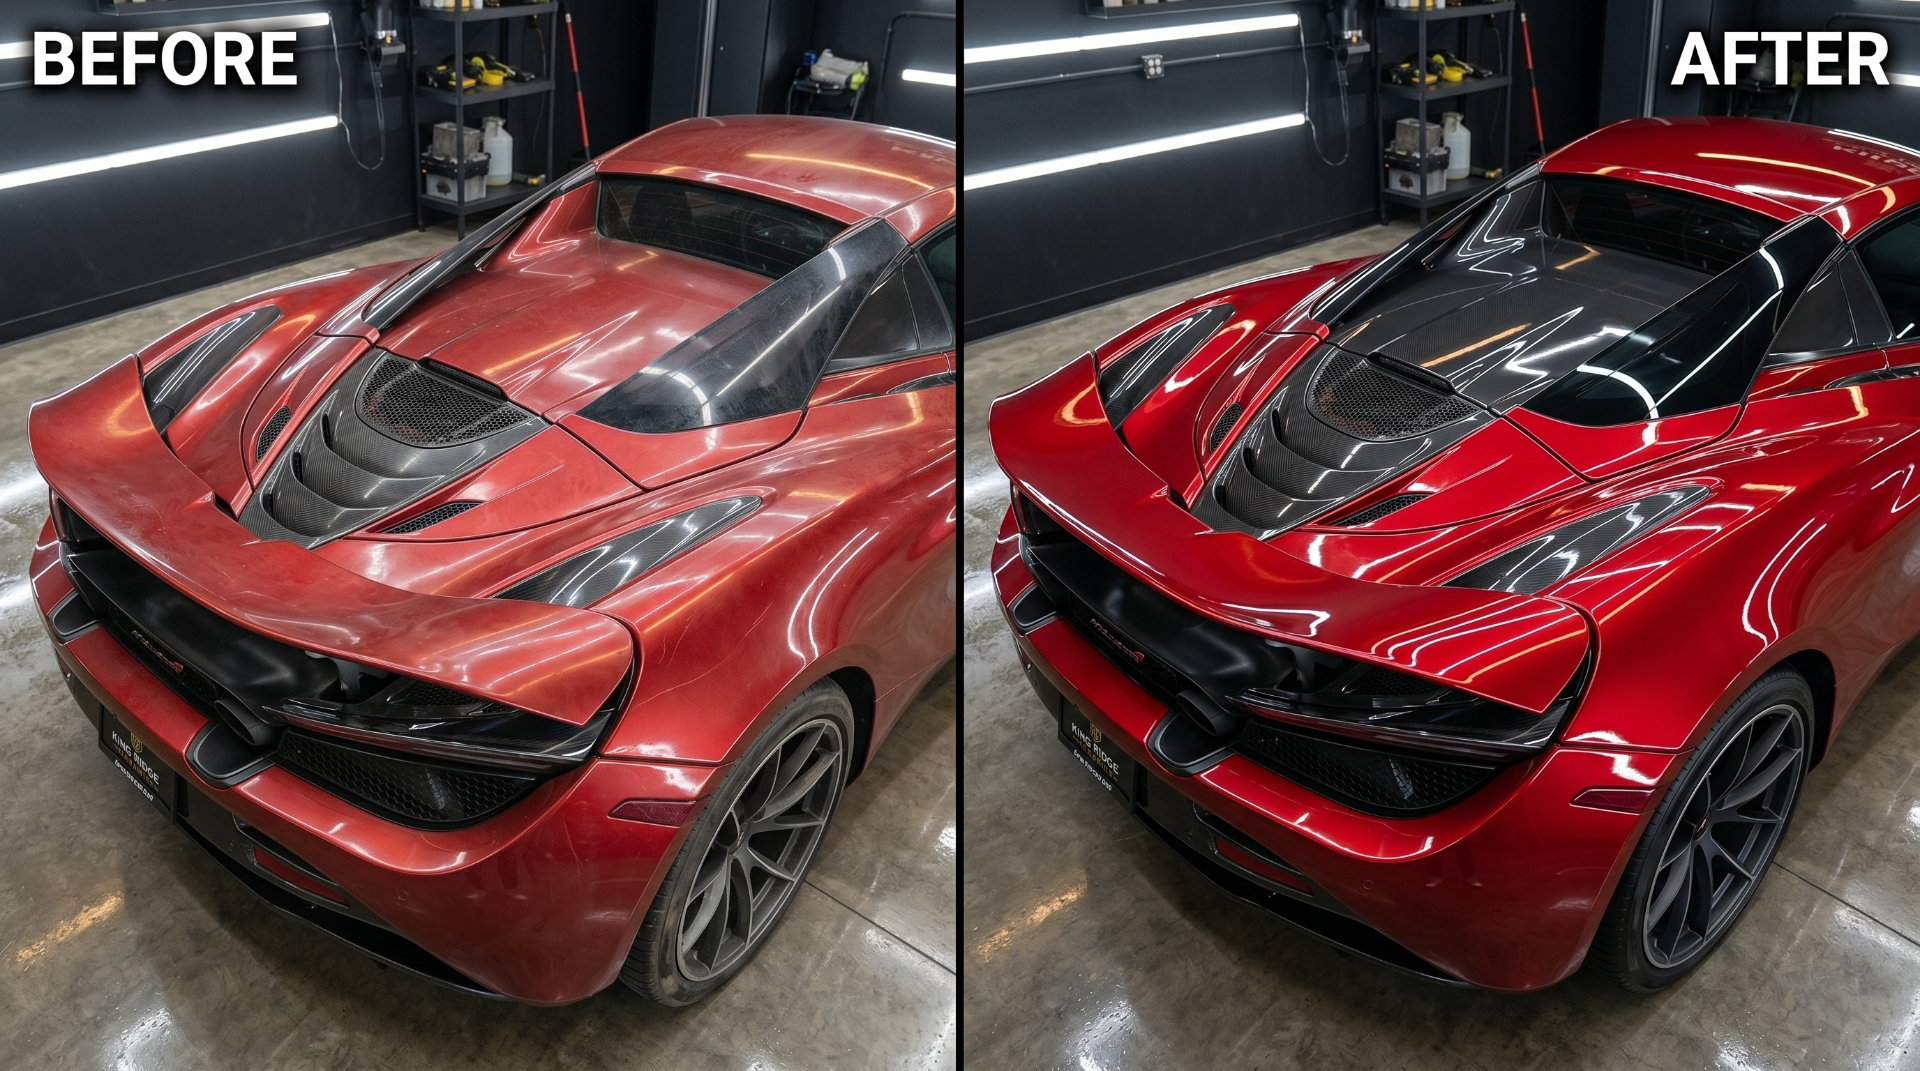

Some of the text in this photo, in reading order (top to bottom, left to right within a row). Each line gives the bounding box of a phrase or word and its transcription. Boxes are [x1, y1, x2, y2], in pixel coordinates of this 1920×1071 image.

[111, 730, 132, 757] KING
[133, 752, 160, 785] RIDGE
[1071, 722, 1092, 748] KING
[1093, 743, 1119, 775] RIDGE
